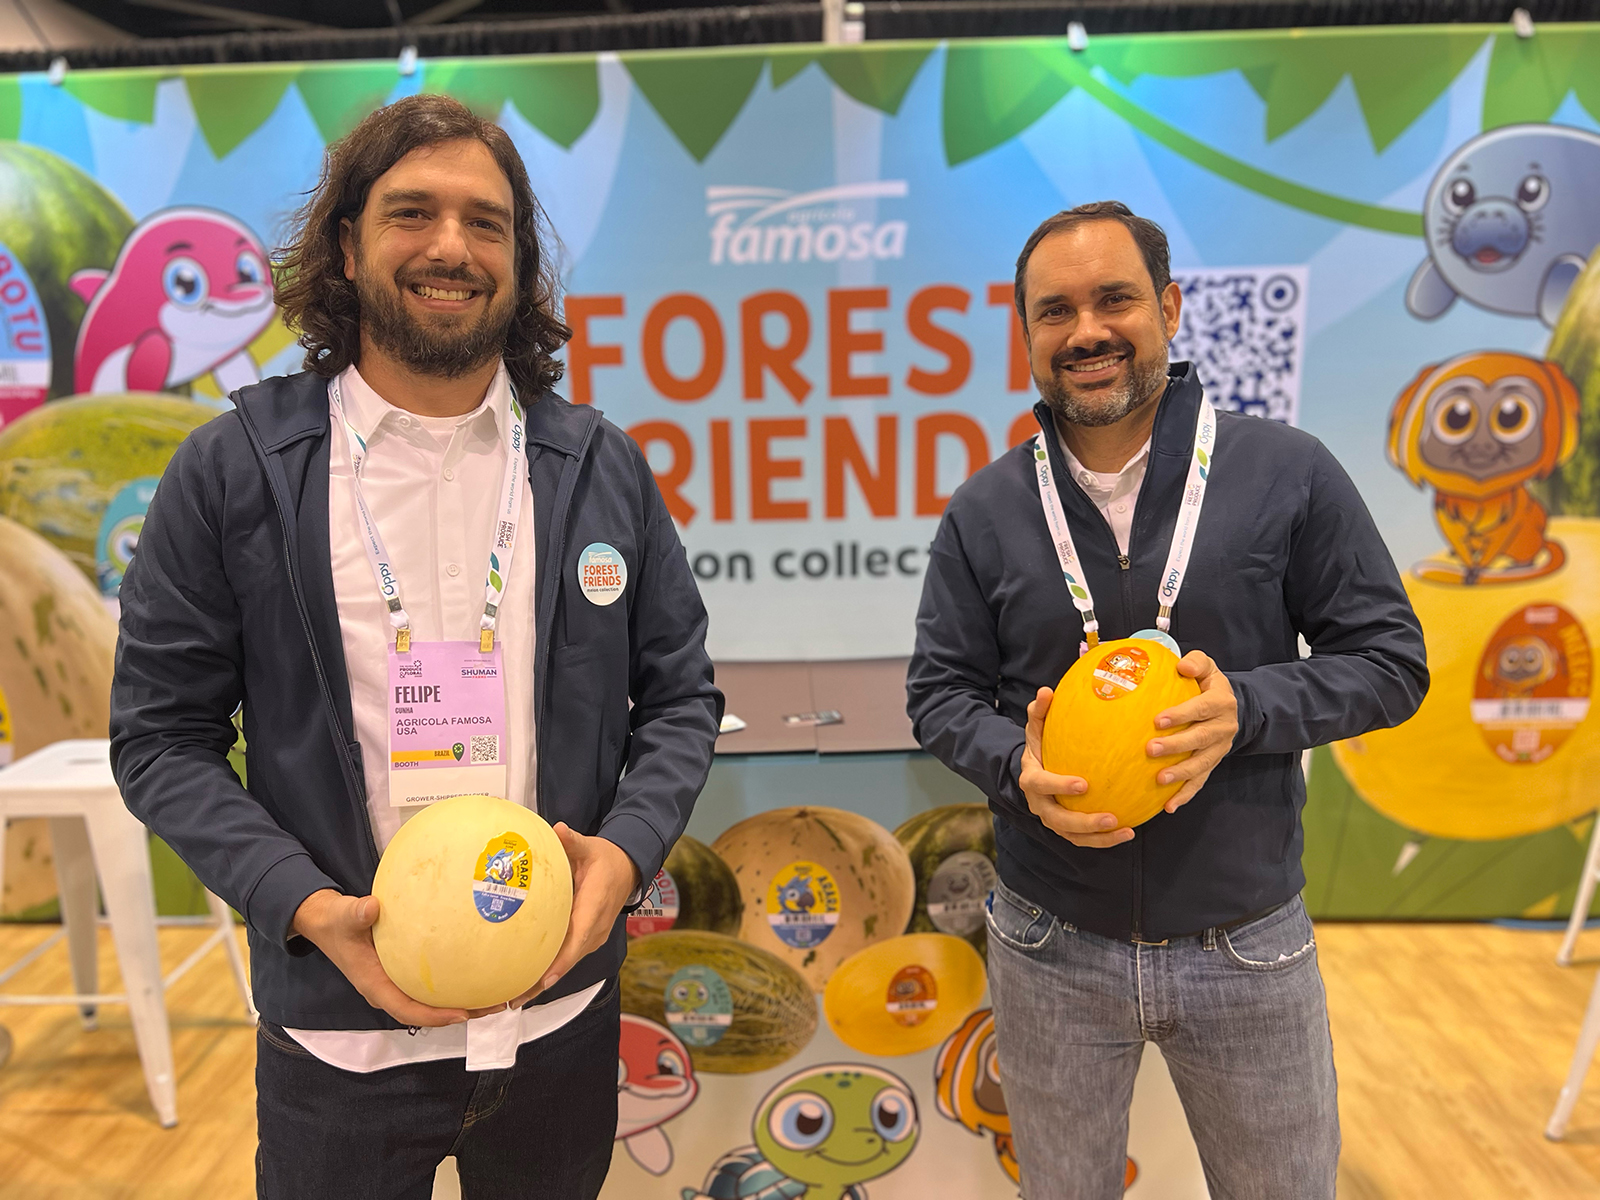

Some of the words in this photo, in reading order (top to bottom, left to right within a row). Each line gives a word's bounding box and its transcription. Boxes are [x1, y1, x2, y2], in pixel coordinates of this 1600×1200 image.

[709, 212, 908, 265] famosa
[564, 283, 1031, 406] FOREST
[511, 424, 523, 453] Oppy
[1199, 422, 1212, 444] Oppy
[624, 411, 1042, 529] RIEND
[1039, 464, 1049, 487] Oppy
[1192, 485, 1201, 506] PRODUCE
[497, 520, 507, 548] PRODUCE
[504, 521, 513, 541] FRESH
[1058, 542, 1069, 565] PRODUCE
[1062, 540, 1071, 557] FRESH
[584, 564, 619, 575] FOREST
[772, 541, 931, 580] collec
[378, 562, 396, 595] Oppy
[583, 575, 621, 587] FRIENDS
[1162, 568, 1180, 597] Oppy
[395, 685, 441, 703] FELIPE
[396, 717, 449, 727] AGRICOLA
[451, 716, 492, 725] FAMOSA
[396, 727, 418, 735] USA
